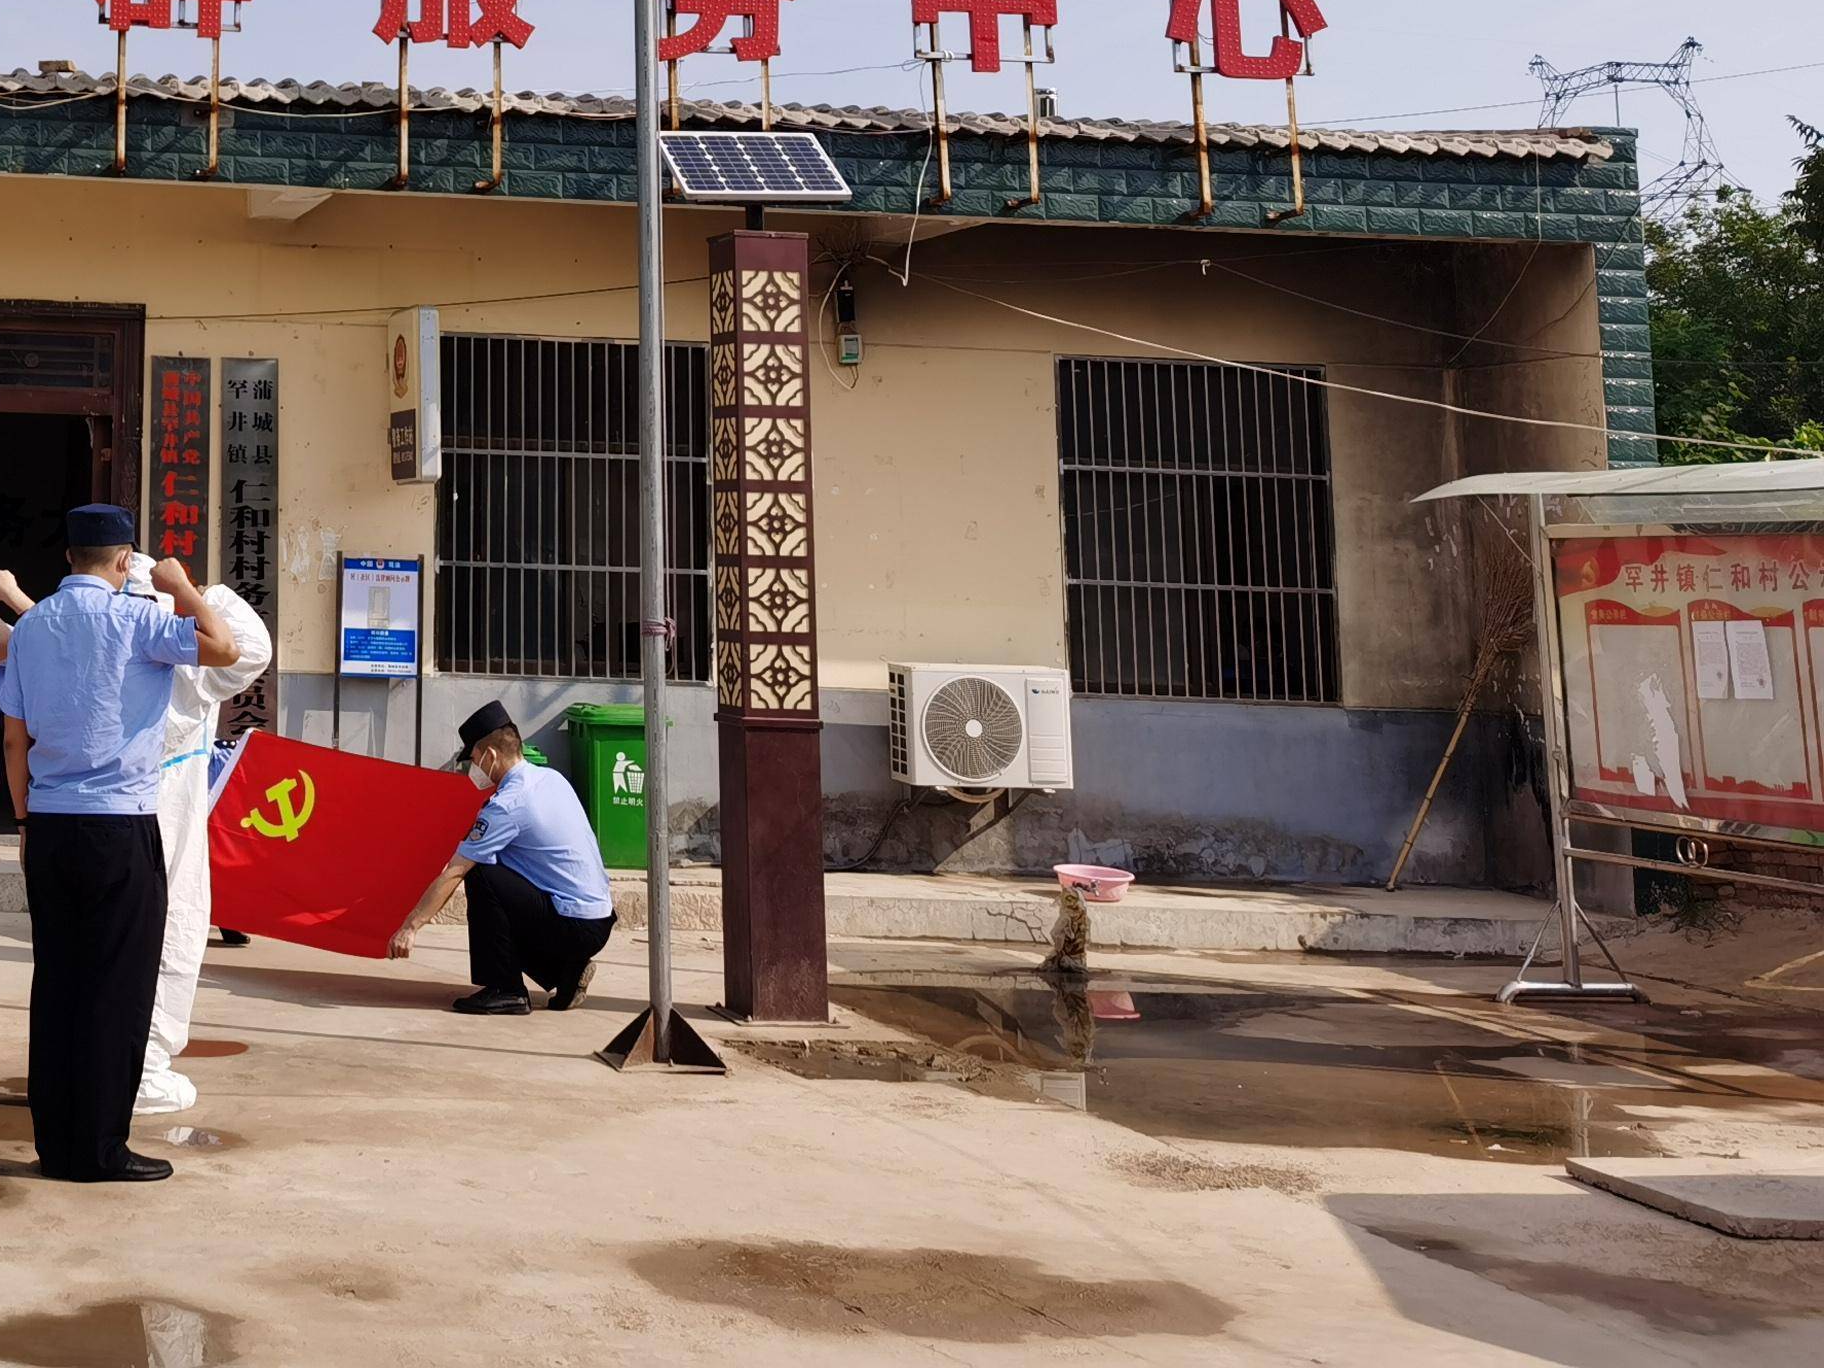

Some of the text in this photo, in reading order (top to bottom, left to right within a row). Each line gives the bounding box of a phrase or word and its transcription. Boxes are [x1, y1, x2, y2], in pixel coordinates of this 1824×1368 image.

[227, 379, 248, 465] 罕井镇
[252, 379, 273, 465] 蒲城县
[229, 478, 271, 736] 仁和村村务员会
